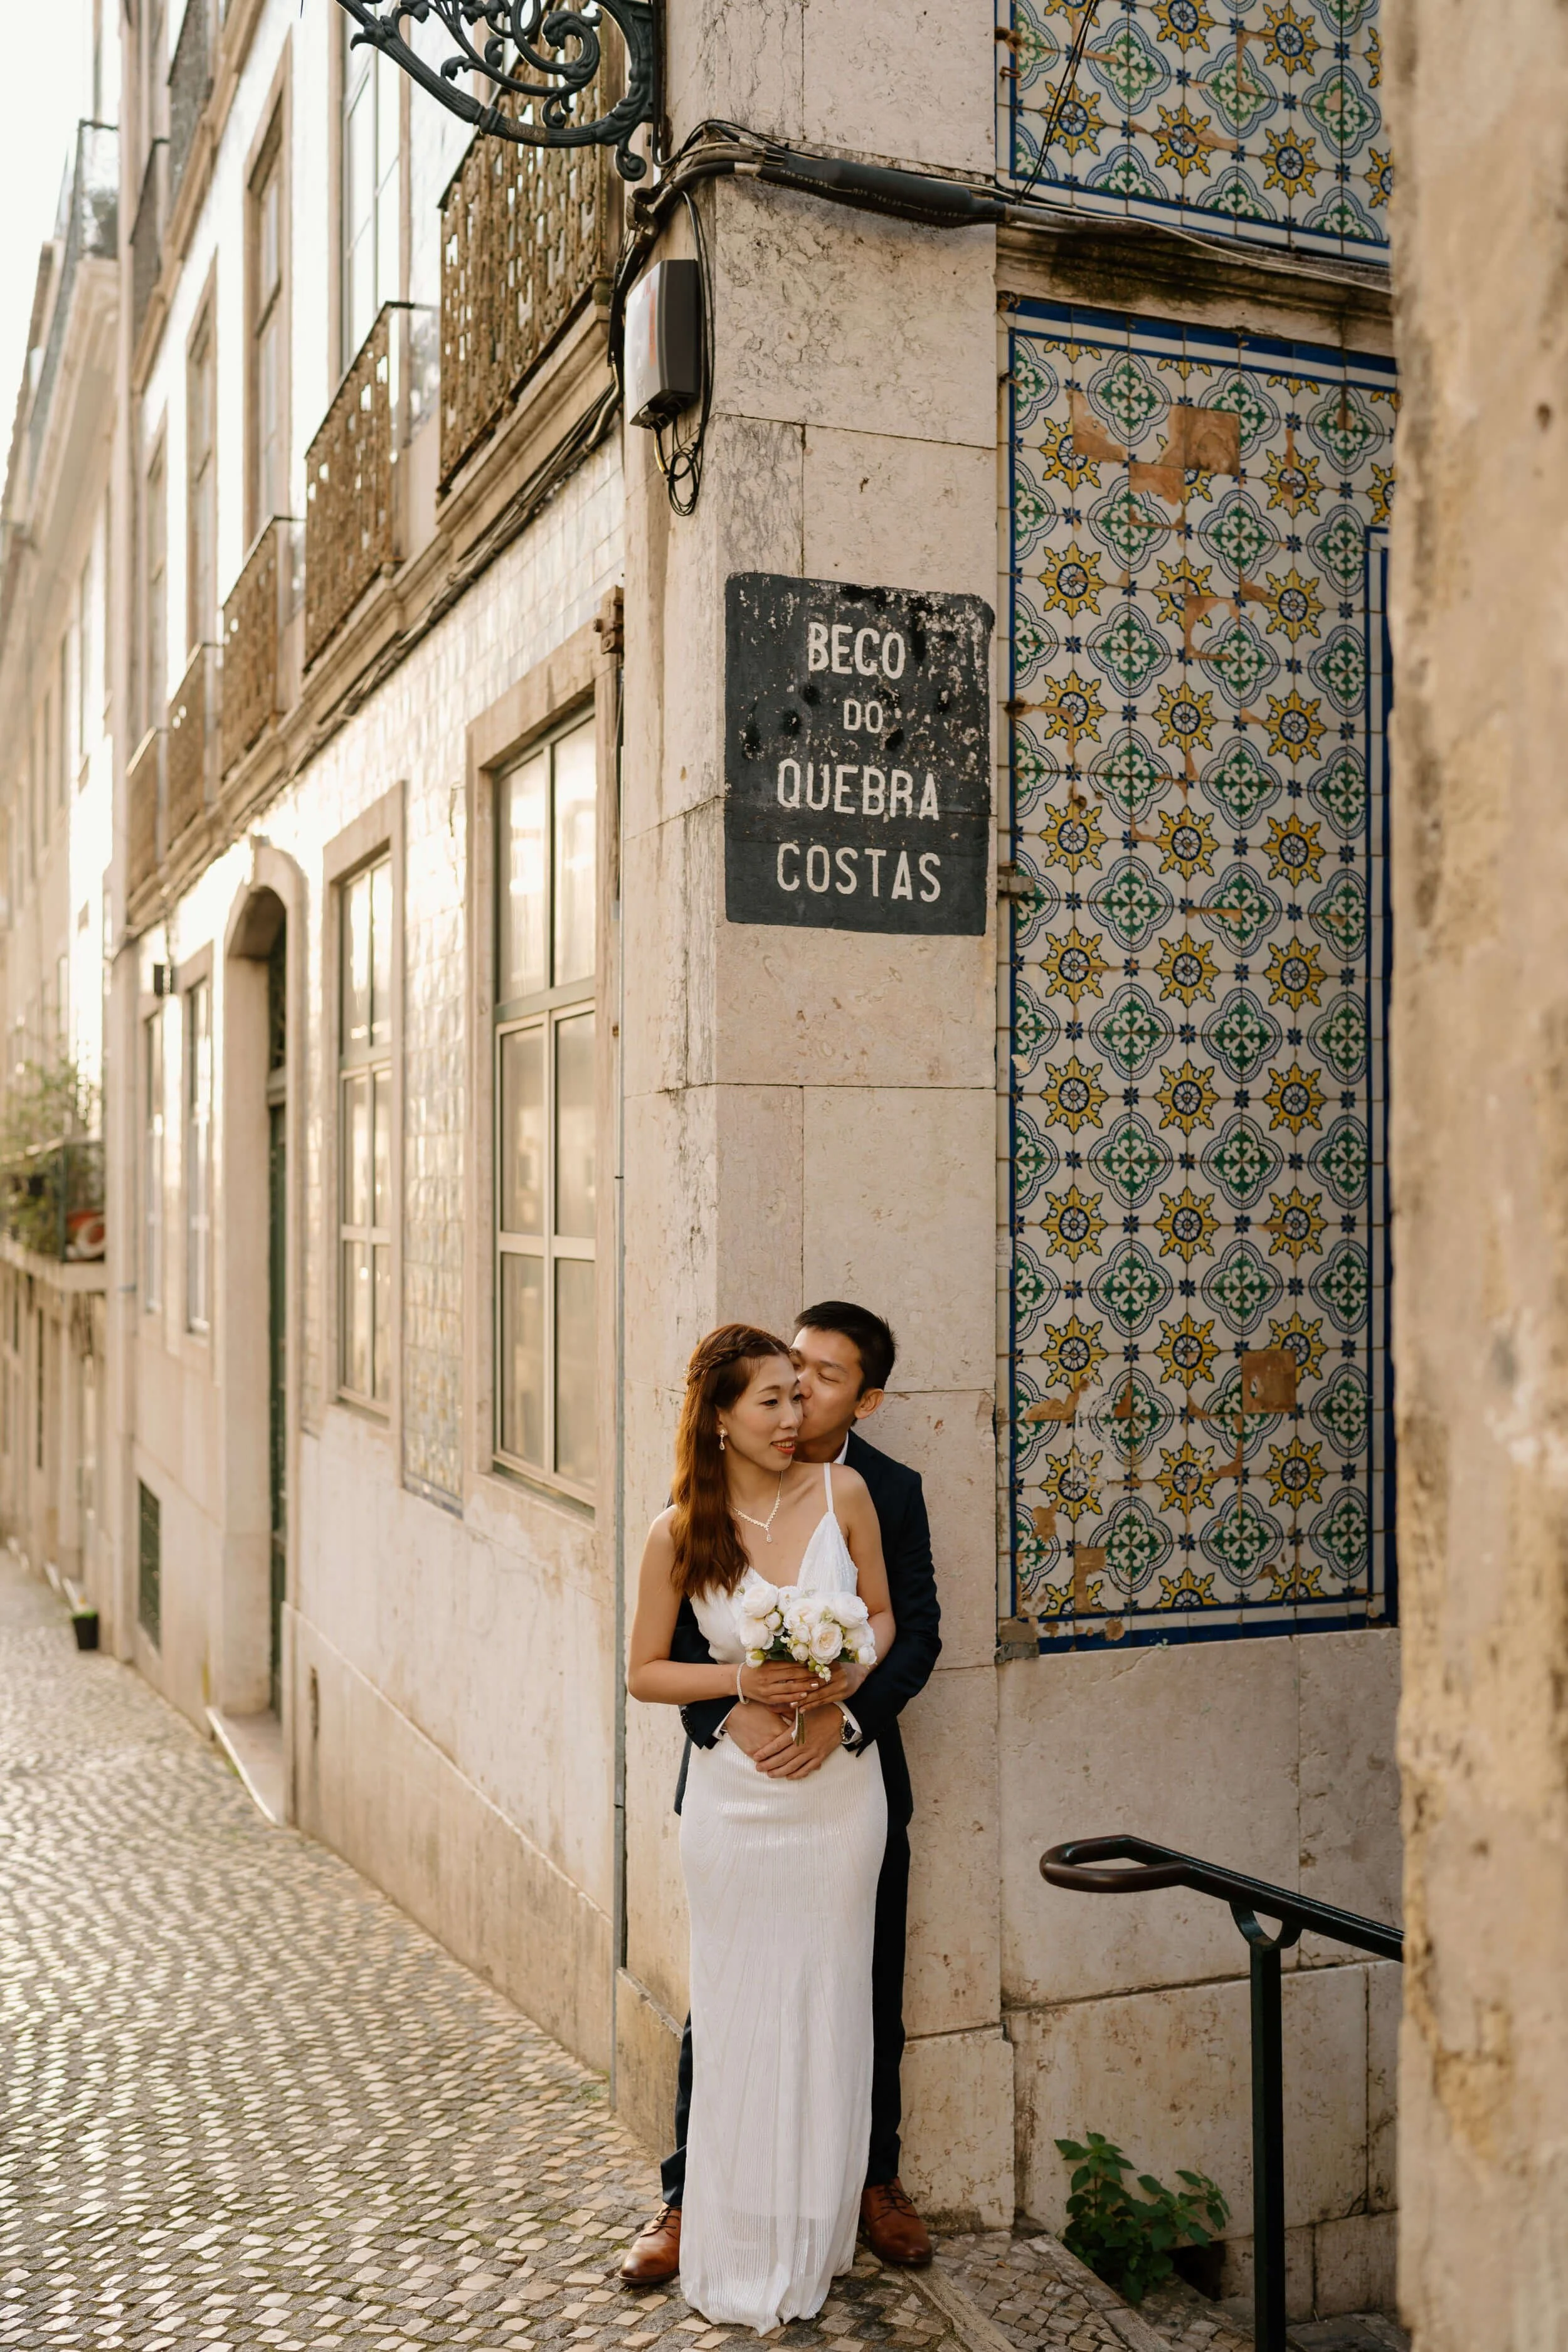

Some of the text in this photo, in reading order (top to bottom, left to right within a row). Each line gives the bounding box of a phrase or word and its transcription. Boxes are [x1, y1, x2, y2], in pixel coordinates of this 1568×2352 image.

[807, 622, 906, 679] BECO
[843, 699, 884, 734] DO
[777, 758, 940, 820] QUEBRA
[776, 842, 941, 902] COSTAS
